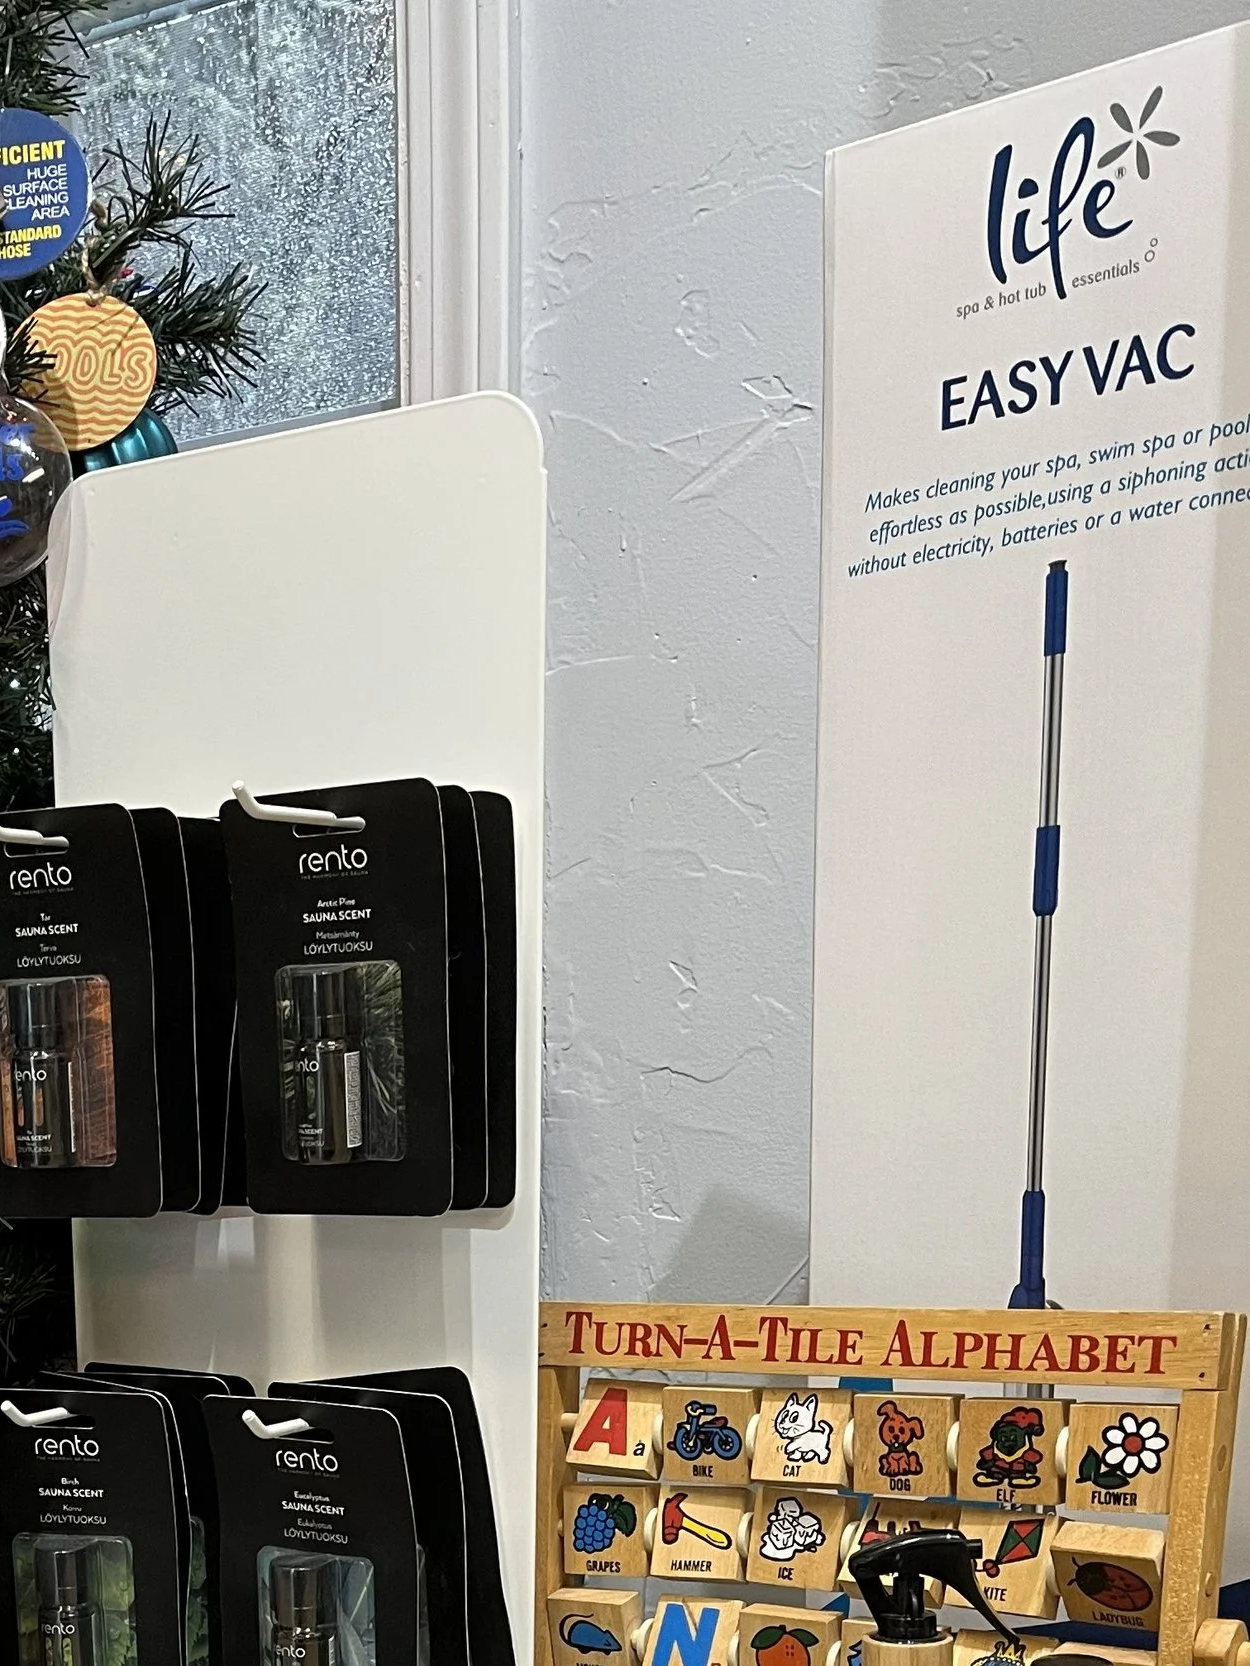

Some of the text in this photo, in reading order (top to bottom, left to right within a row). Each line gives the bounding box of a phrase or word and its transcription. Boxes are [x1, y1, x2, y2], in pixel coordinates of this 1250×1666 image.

[27, 164, 68, 180] HUGE
[4, 177, 68, 197] SURFACE
[32, 206, 71, 222] AREA
[986, 116, 1134, 300] life
[956, 259, 1141, 319] spa & hot tub essentials
[940, 322, 1197, 432] EASY VAC
[865, 488, 920, 513] Makes
[926, 470, 996, 499] cleaning
[1001, 461, 1041, 490] your
[1045, 453, 1081, 477] spa,
[1089, 441, 1135, 465] swim
[1142, 434, 1176, 458] spa
[1183, 428, 1203, 445] or
[869, 514, 943, 545] effortless
[949, 509, 968, 526] as
[1100, 479, 1112, 495] a
[1118, 461, 1207, 495] siphoning
[299, 844, 368, 874] rento
[10, 862, 72, 890] rento
[302, 908, 372, 923] SAUNA SCENT
[15, 923, 79, 937] SAUNA SCENT
[573, 1387, 628, 1456] A
[35, 1434, 99, 1456] rento
[275, 1448, 338, 1472] rento
[692, 1465, 714, 1479] BIKE
[782, 1465, 802, 1478] CAT
[38, 1487, 104, 1498] SAUNA SCENT
[889, 1478, 911, 1492] DOG
[996, 1488, 1017, 1503] ELF
[1091, 1490, 1138, 1507] FLOWER
[282, 1500, 345, 1516] SAUNA SCENT
[586, 1559, 621, 1573] GRAPES
[670, 1559, 712, 1573] HAMMER
[778, 1566, 795, 1581] ICE
[983, 1586, 1007, 1602] KITE
[1091, 1611, 1144, 1627] LADYBUG
